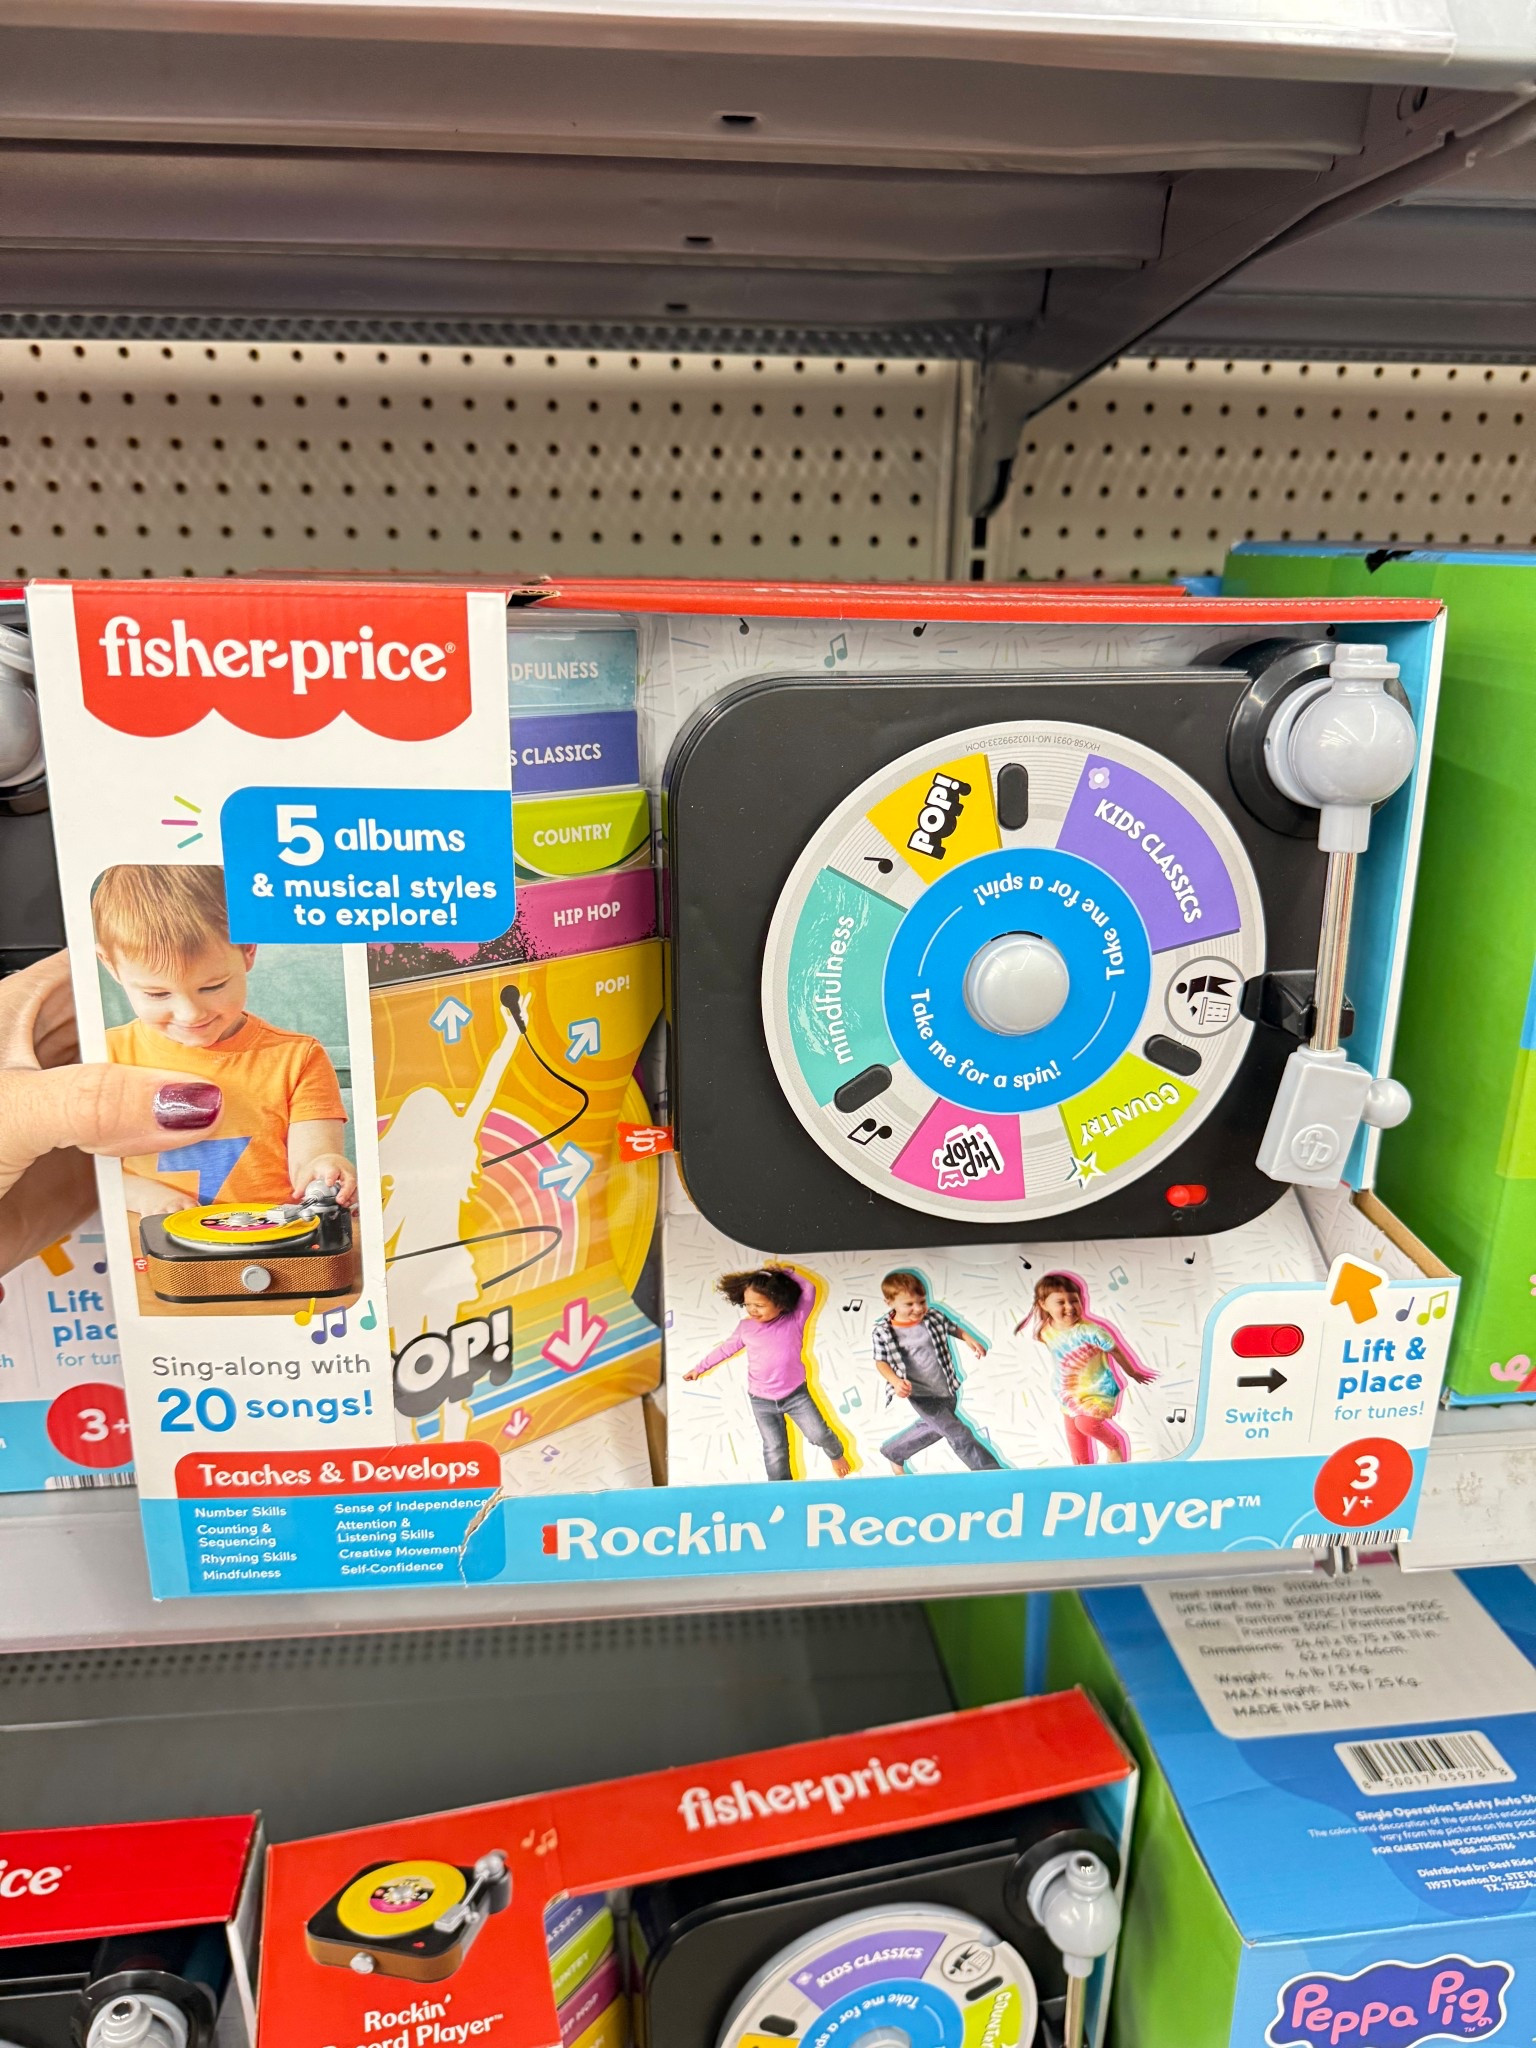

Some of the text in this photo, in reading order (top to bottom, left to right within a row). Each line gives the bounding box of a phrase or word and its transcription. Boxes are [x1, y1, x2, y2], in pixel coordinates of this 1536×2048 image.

[508, 661, 599, 681] DFULNESS
[522, 743, 602, 765] CLASSICS
[908, 771, 971, 860] POP!
[275, 804, 466, 868] 5 albums
[532, 822, 613, 848] COUNTRY
[1093, 798, 1203, 925] KIDS CLASSICS
[252, 873, 497, 903] & musical styles
[294, 902, 459, 931] to explore!
[553, 900, 621, 929] HIP HOP
[973, 873, 1126, 980] Take me for a spin!
[595, 975, 630, 996] POP!
[816, 914, 856, 1066] mindfulness
[910, 988, 1062, 1091] Take me for a spin!
[1081, 1083, 1180, 1146] COUNTRY
[48, 1289, 104, 1313] Lift
[56, 1352, 85, 1367] for
[395, 1306, 513, 1402] OP!
[1342, 1336, 1426, 1364] Lift &
[152, 1353, 371, 1381] Sing-along with
[1337, 1370, 1423, 1399] place
[157, 1387, 374, 1432] 20 songs!
[1225, 1407, 1294, 1425] Switch
[1334, 1400, 1425, 1421] for tunes!
[1245, 1425, 1270, 1440] on
[197, 1457, 480, 1487] Teaches & Develops
[1349, 1455, 1380, 1491] 3
[194, 1506, 287, 1519] Number Skills
[334, 1498, 489, 1516] Sense of Independence
[1342, 1495, 1373, 1517] y+
[197, 1523, 272, 1537] Counting &
[336, 1517, 411, 1531] Attention &
[806, 1491, 1022, 1549] Record
[198, 1536, 276, 1550] Sequencing
[337, 1528, 435, 1544] Listening Skills
[201, 1550, 297, 1567] Rhyming Skills
[339, 1544, 464, 1560] Creative Movement
[203, 1567, 282, 1581] Mindfulness
[341, 1560, 444, 1575] Self-Confidence
[1232, 1704, 1281, 1717] MADE
[1355, 1808, 1393, 1822] Single
[1393, 1802, 1453, 1819] Operation
[1453, 1798, 1493, 1812] Safety
[1493, 1796, 1520, 1808] Auto
[1307, 1828, 1327, 1838] The
[1378, 1819, 1428, 1832] decoration
[1459, 1812, 1499, 1826] products
[1403, 1829, 1428, 1840] from
[1444, 1823, 1482, 1837] pictures
[1371, 1845, 1391, 1856] FOR
[1391, 1841, 1442, 1854] QUESTION
[1443, 1838, 1463, 1849] AND
[1417, 1863, 1474, 1878] Distributed
[1489, 1860, 1511, 1871] Best
[1511, 1858, 1533, 1868] Ride
[1453, 1875, 1489, 1887] Denton
[1504, 1872, 1525, 1882] STE
[815, 1946, 925, 1989] KIDS CLASSICS
[862, 1994, 886, 2010] me
[887, 1992, 920, 2010] Take
[1291, 1970, 1492, 2046] Peppa Pig
[839, 2005, 862, 2025] for
